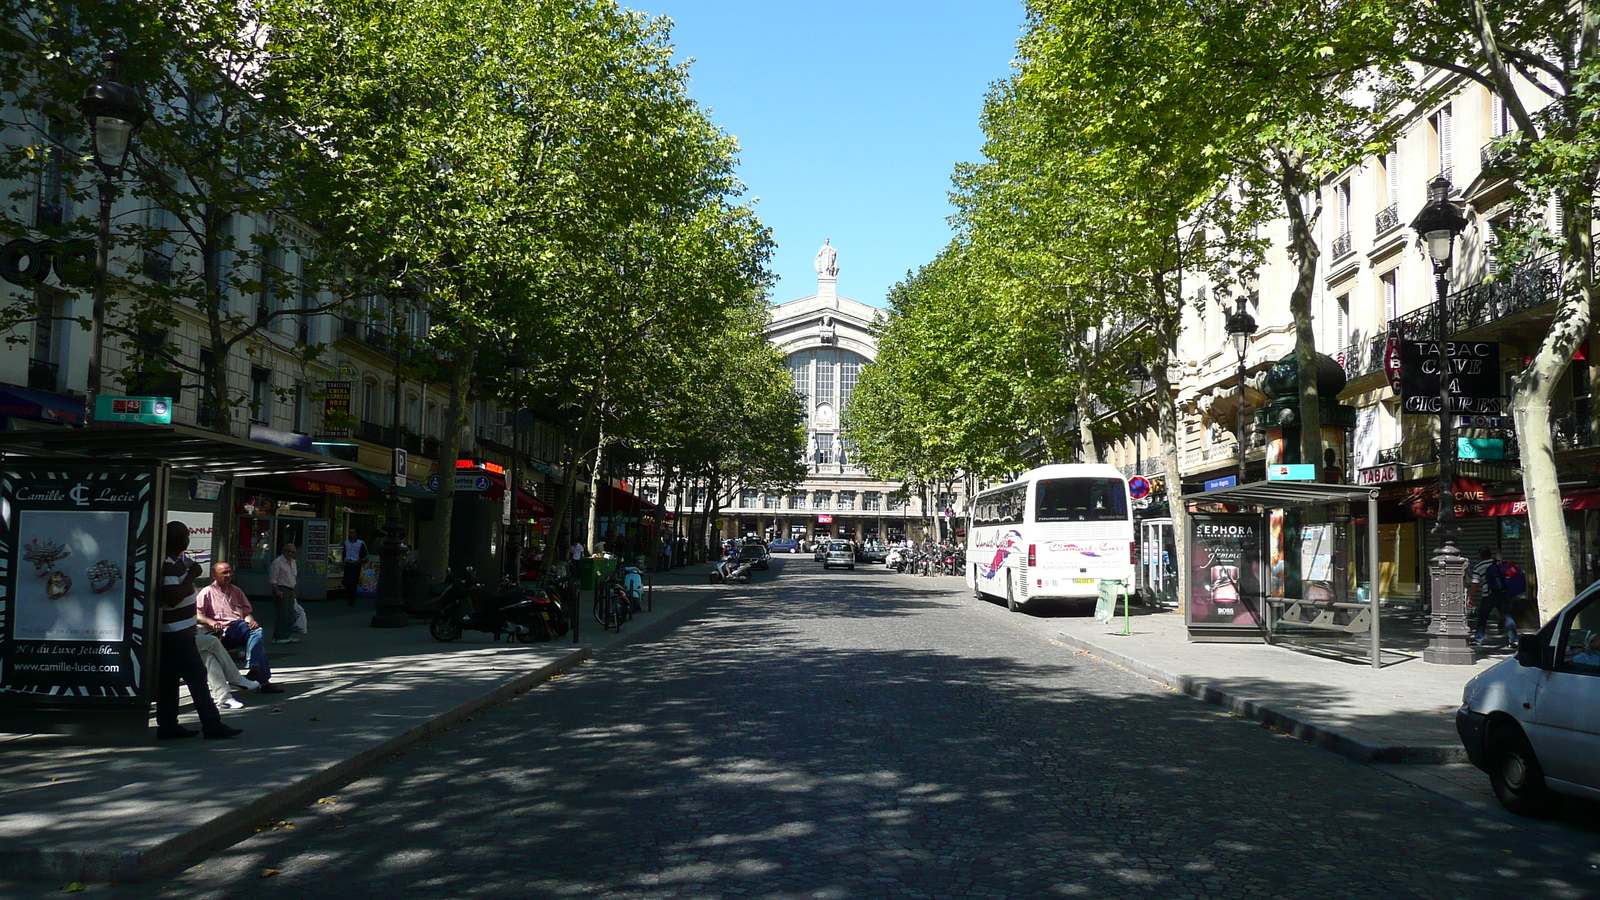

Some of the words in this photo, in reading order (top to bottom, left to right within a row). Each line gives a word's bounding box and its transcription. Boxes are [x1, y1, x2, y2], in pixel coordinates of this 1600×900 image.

[1414, 343, 1490, 357] TABAC
[1389, 337, 1401, 391] TABAC
[1422, 359, 1483, 375] CAVE
[127, 400, 139, 410] 43
[1460, 415, 1515, 428] LOTO
[399, 454, 405, 467] P
[1363, 466, 1395, 483] TABAC
[15, 487, 66, 502] Camille
[94, 488, 136, 502] Lucie
[1454, 491, 1485, 501] CAVE
[1196, 525, 1254, 535] SEPHORA
[1200, 545, 1242, 569] femme
[37, 644, 50, 654] du
[51, 645, 76, 654] Luxe
[14, 661, 120, 673] www.camille-lucie.com
